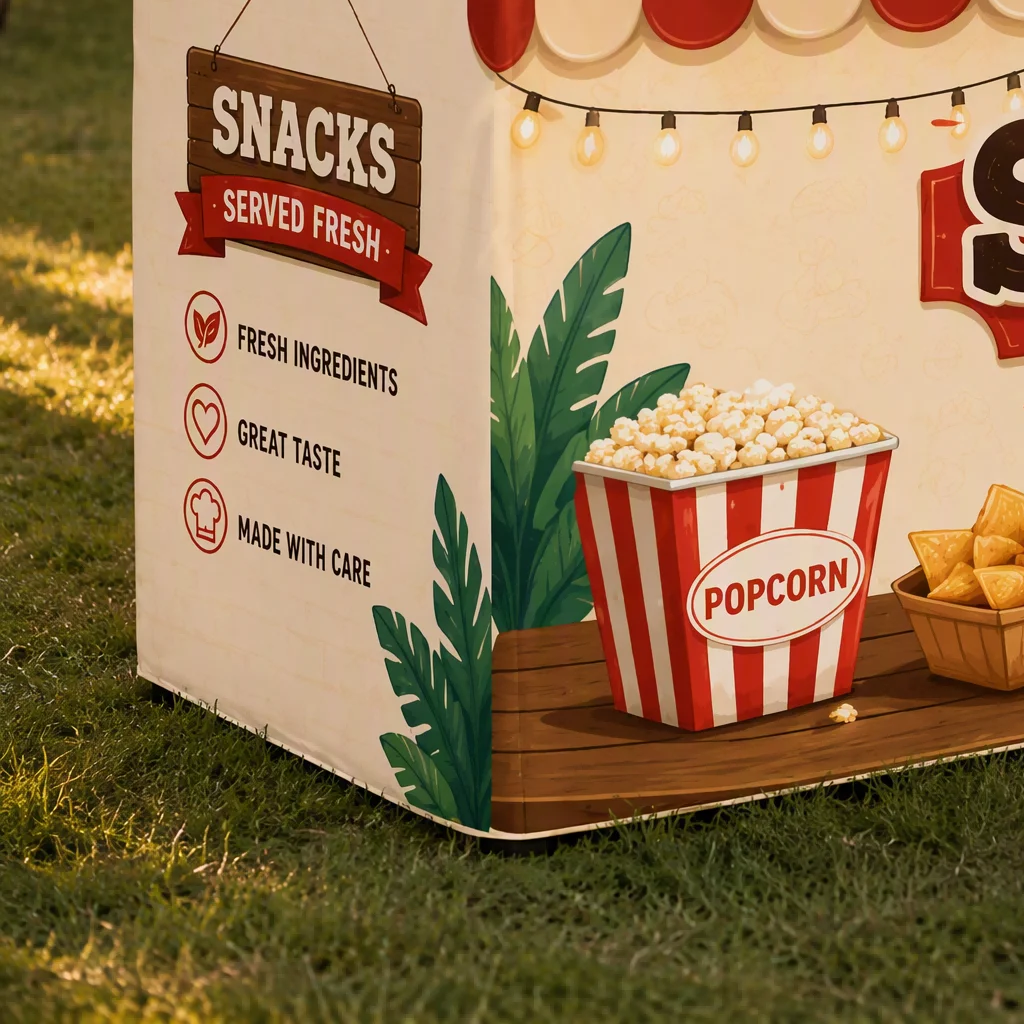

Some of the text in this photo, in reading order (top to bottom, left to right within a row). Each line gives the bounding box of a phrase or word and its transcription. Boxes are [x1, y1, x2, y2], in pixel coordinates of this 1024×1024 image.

[212, 85, 396, 194] SNACKS
[223, 188, 381, 263] SERVED FRESH
[237, 323, 398, 397] FRESH INGREDIENTS
[237, 418, 341, 479] GREAT TASTE
[237, 515, 371, 589] MADE WITH CARE
[704, 557, 848, 621] POPCORN
